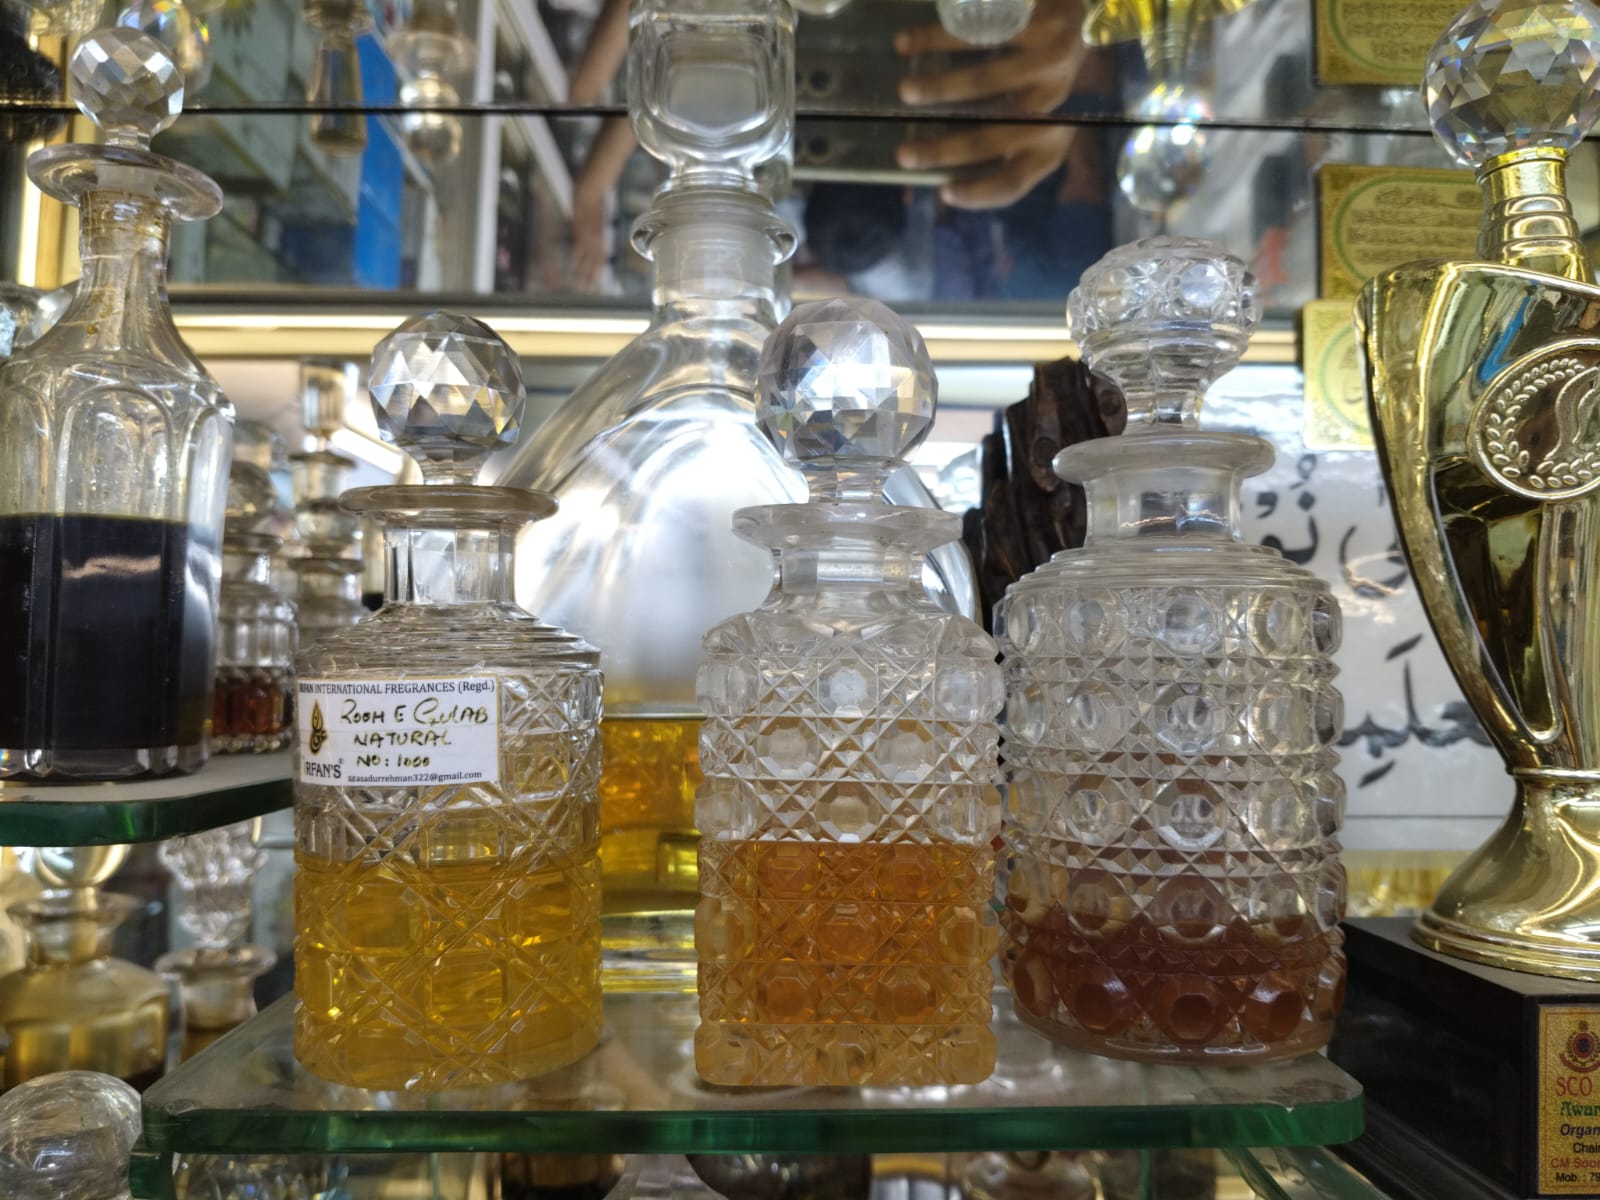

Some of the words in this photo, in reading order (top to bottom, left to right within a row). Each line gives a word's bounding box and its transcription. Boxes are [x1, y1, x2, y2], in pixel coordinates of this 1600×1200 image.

[315, 683, 383, 694] INTERNATIONAL
[385, 683, 455, 694] FREGRANCES
[458, 680, 495, 694] (Regd.)
[394, 705, 406, 722] E
[353, 730, 452, 748] NATURAL
[397, 754, 430, 767] 1000
[1556, 1076, 1592, 1097] SCO
[1551, 1157, 1569, 1169] CM
